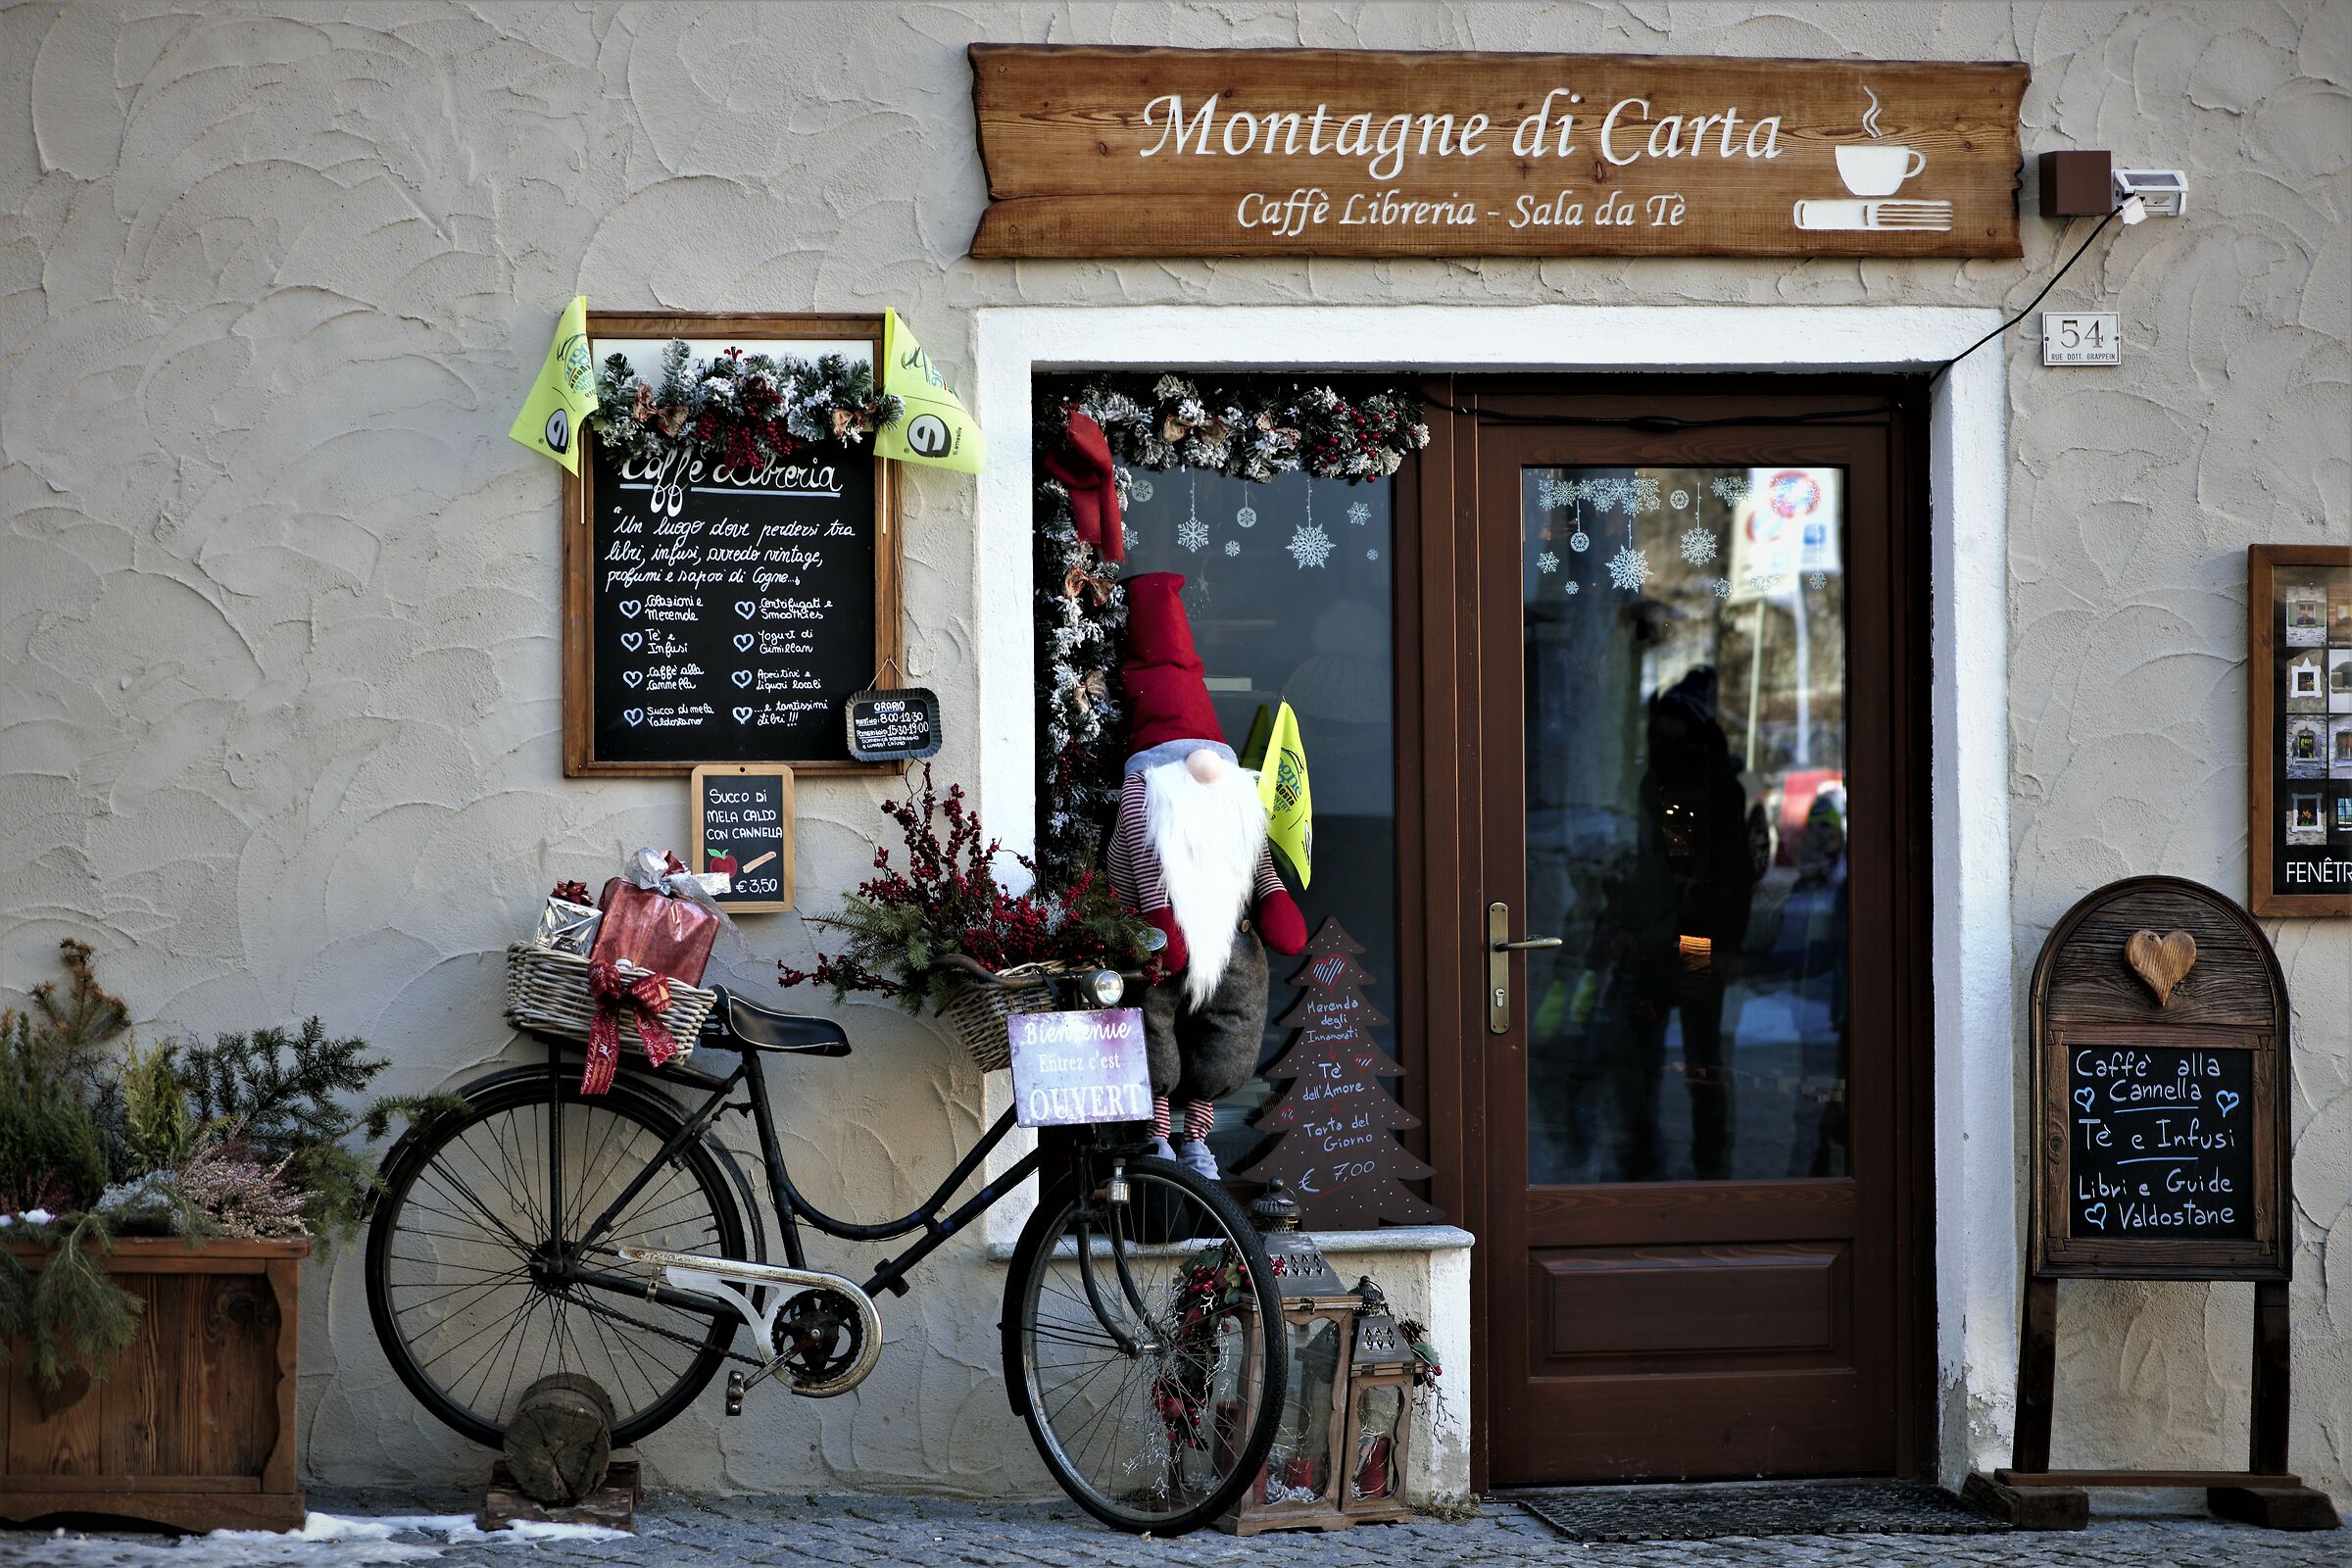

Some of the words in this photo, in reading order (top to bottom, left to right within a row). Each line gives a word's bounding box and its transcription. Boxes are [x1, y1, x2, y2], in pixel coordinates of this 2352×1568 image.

[1140, 93, 1490, 180] Montagne
[1512, 87, 1581, 158] di
[1600, 97, 1784, 166] Carta
[1237, 188, 1330, 236] Caffè
[1339, 188, 1477, 225] Libreria
[1508, 189, 1584, 228] Sala
[1594, 190, 1636, 226] da
[1646, 192, 1687, 226] Tè
[2061, 319, 2104, 349] 54
[653, 516, 705, 547] luogo
[710, 517, 750, 537] dove
[757, 519, 820, 546] perdersi
[824, 518, 856, 536] tra
[706, 546, 760, 562] arredo
[605, 568, 662, 592] profumi
[664, 572, 673, 582] e
[677, 569, 726, 590] sapori
[728, 568, 746, 584] di
[644, 594, 694, 608] Colazioni
[697, 597, 704, 607] e
[760, 598, 820, 613] Centrifugati
[644, 608, 698, 621] Merende
[760, 608, 823, 619] Smoothies
[758, 630, 795, 645] Yogurt
[801, 629, 813, 638] di
[648, 641, 688, 658] Infusi
[646, 665, 678, 680] Caffè
[680, 663, 704, 675] alla
[757, 668, 800, 682] Aperitivi
[646, 677, 696, 691] Cannella
[792, 678, 821, 690] locali
[678, 703, 688, 714] di
[690, 703, 714, 714] mela
[775, 699, 828, 711] tantissimi
[873, 701, 906, 711] ORARIO
[647, 716, 704, 726] Valdostano
[707, 810, 738, 823] MELA
[743, 808, 776, 822] CALDO
[706, 829, 728, 840] CON
[732, 826, 783, 839] CANNELLA
[749, 878, 778, 894] 3,50
[1306, 995, 1358, 1013] Merenda
[1320, 1013, 1348, 1029] degli
[1306, 1025, 1358, 1043] Innamorati
[1038, 1054, 1084, 1073] Entrez
[1090, 1051, 1121, 1070] c'est
[2076, 1050, 2151, 1077] Caffè
[2178, 1052, 2221, 1077] alla
[1302, 1082, 1365, 1101] dell'Amore
[2109, 1078, 2202, 1102] Cannella
[1029, 1083, 1142, 1122] OUVERT
[1302, 1116, 1343, 1137] Torta
[1351, 1112, 1369, 1129] del
[1323, 1133, 1373, 1152] Giorno
[2132, 1133, 2145, 1150] e
[2156, 1118, 2234, 1150] Infusi
[1333, 1160, 1375, 1182] 7,00
[2079, 1172, 2128, 1200] Libri
[2138, 1182, 2150, 1197] e
[2166, 1166, 2233, 1193] Guide
[2118, 1199, 2235, 1230] Valdostane
